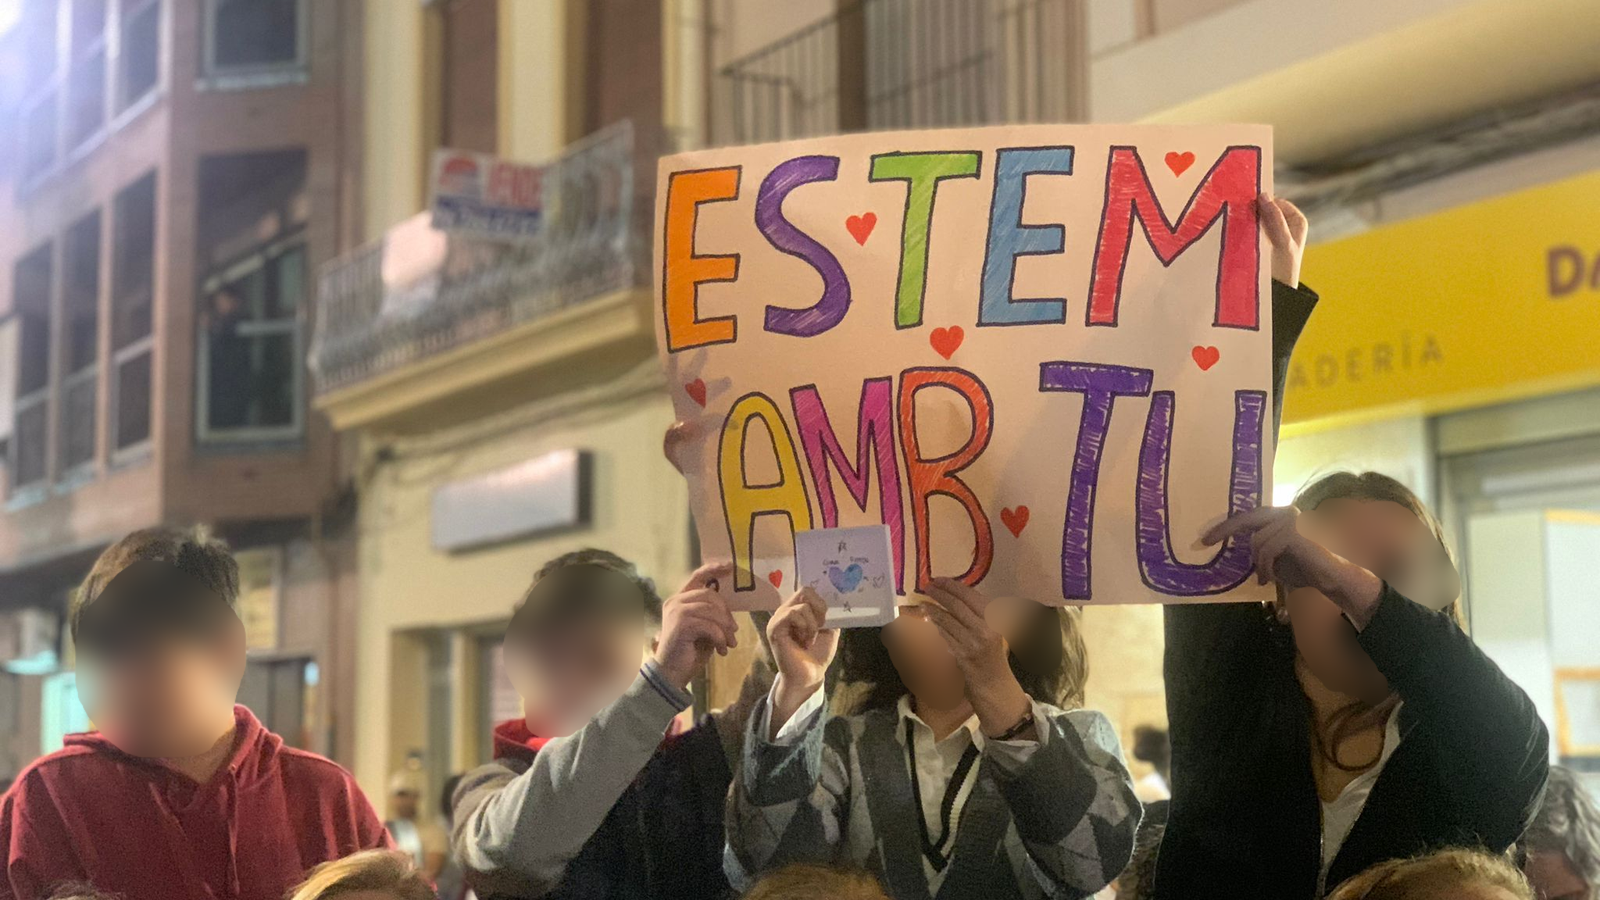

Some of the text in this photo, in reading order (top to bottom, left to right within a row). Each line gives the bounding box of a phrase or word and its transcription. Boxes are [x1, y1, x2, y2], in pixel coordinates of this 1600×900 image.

[662, 145, 1262, 352] ESTEM
[719, 361, 1267, 600] AMB TU
